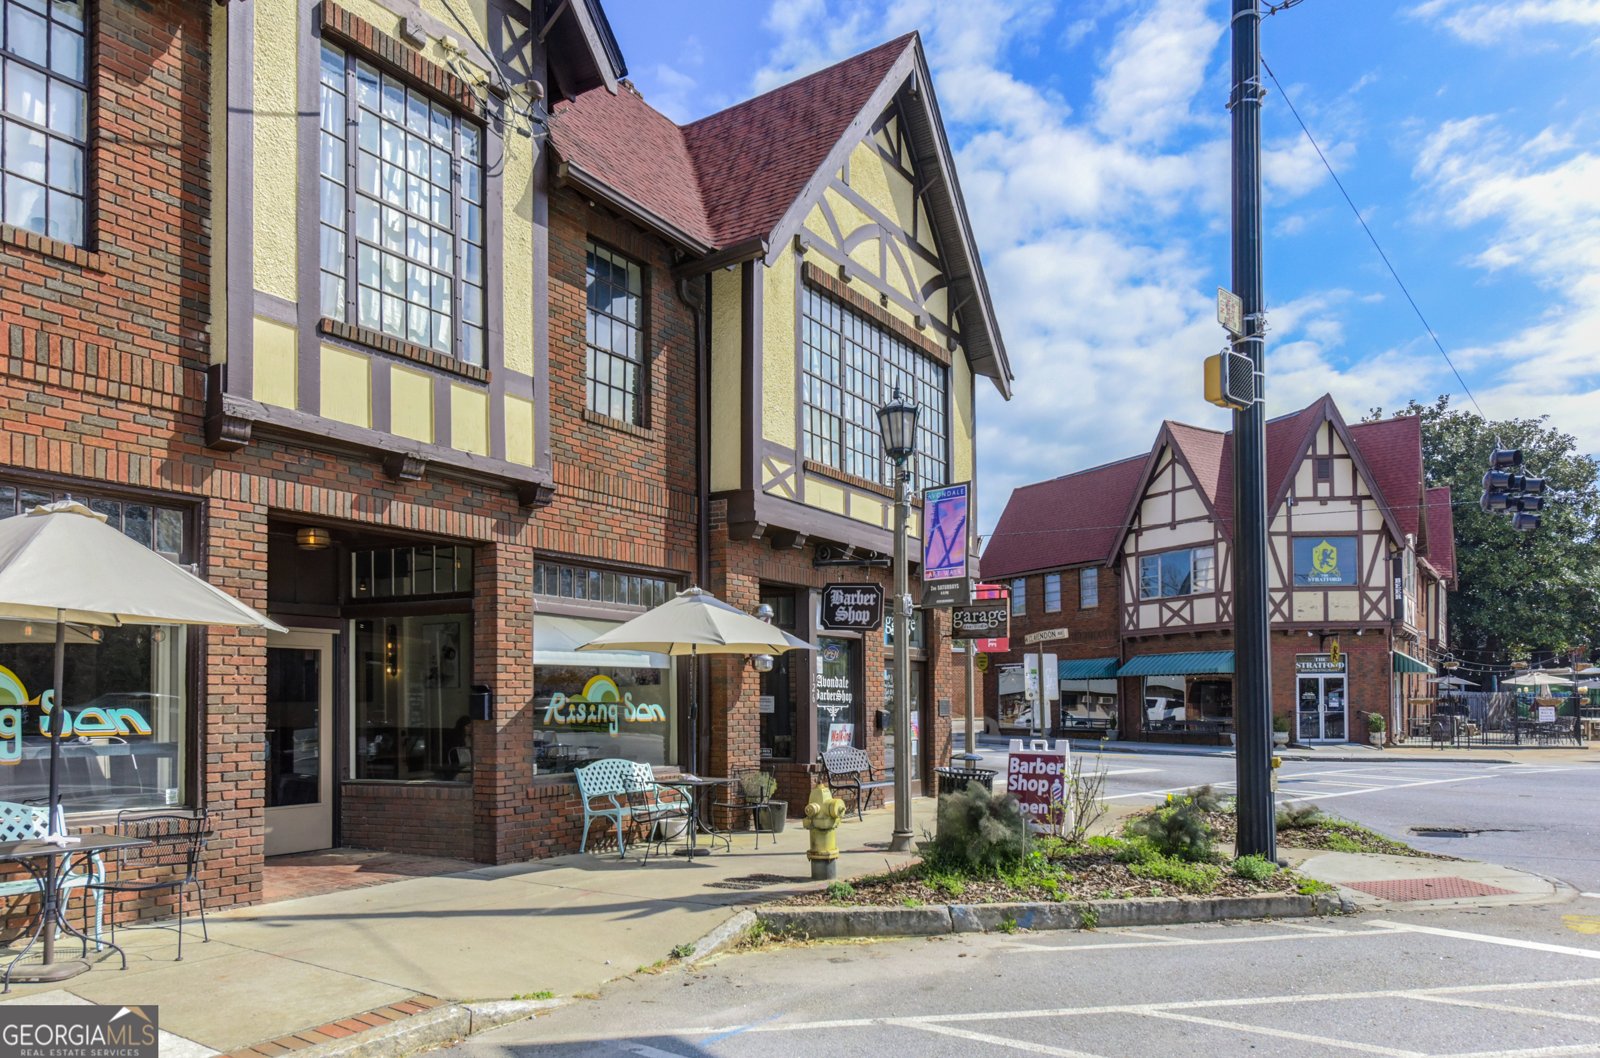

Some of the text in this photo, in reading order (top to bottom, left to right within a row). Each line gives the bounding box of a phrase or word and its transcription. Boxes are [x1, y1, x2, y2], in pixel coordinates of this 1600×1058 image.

[927, 488, 965, 500] AVONDALE
[830, 589, 876, 606] Barber
[834, 606, 871, 625] Shop
[953, 609, 1007, 629] garage
[1029, 630, 1057, 642] CLARENDON
[816, 674, 849, 688] Avondale
[39, 689, 152, 738] Son
[543, 691, 667, 737] Rising Son
[1009, 757, 1064, 775] Barber
[1008, 774, 1049, 796] Shop
